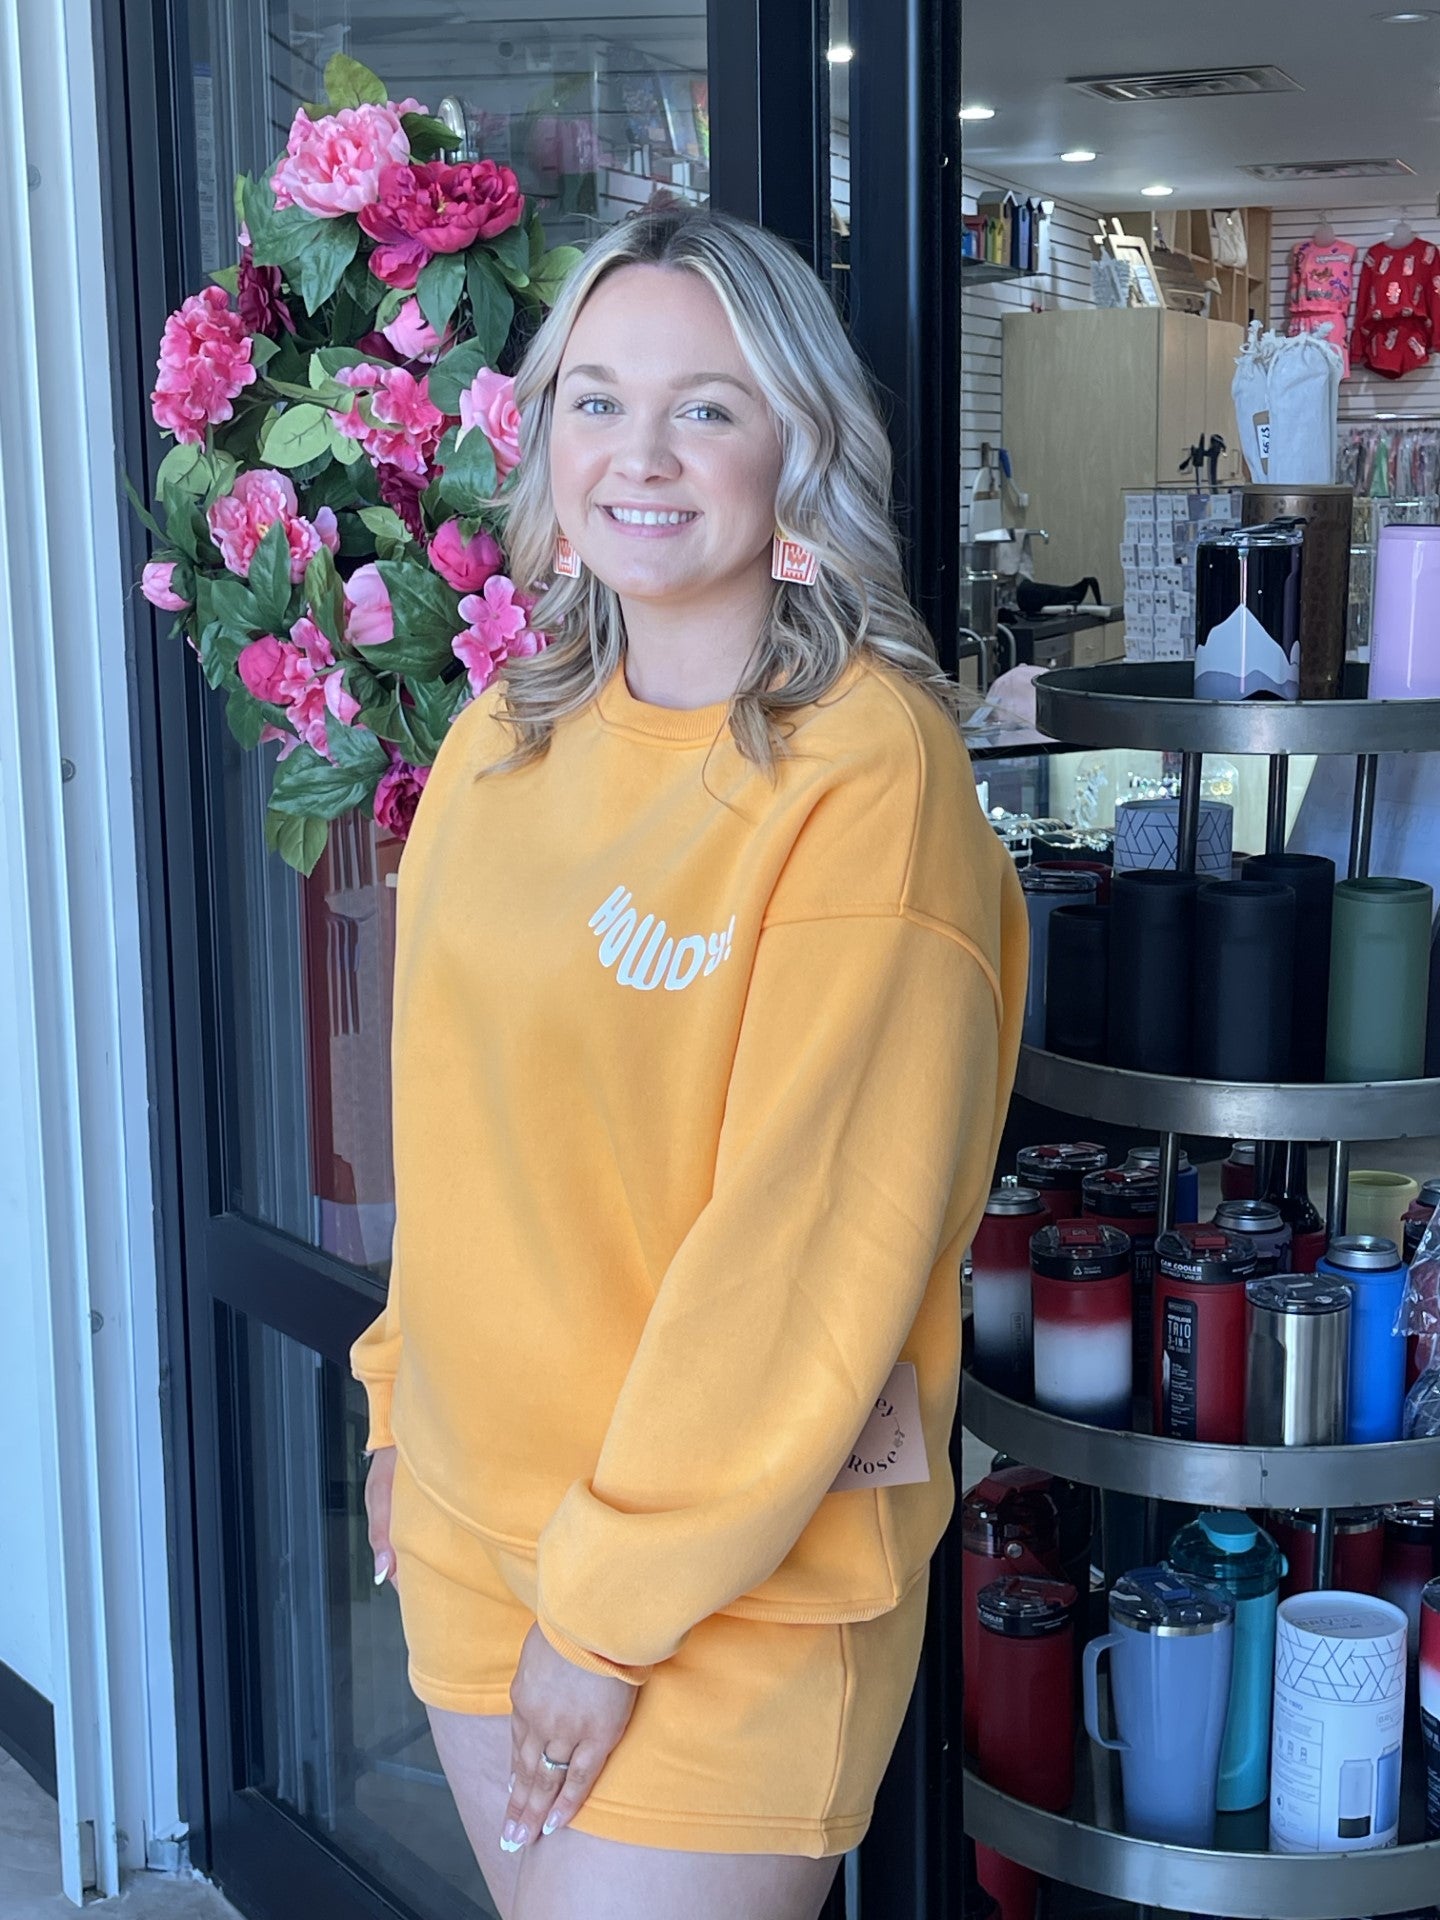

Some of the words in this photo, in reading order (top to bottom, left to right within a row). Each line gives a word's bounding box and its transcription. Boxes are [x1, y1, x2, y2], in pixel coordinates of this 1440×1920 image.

[588, 885, 736, 991] HOWDY!
[1173, 1263, 1202, 1273] COOLER
[1168, 1319, 1191, 1339] TRIO
[875, 1398, 894, 1418] ey
[847, 1450, 897, 1474] Rose
